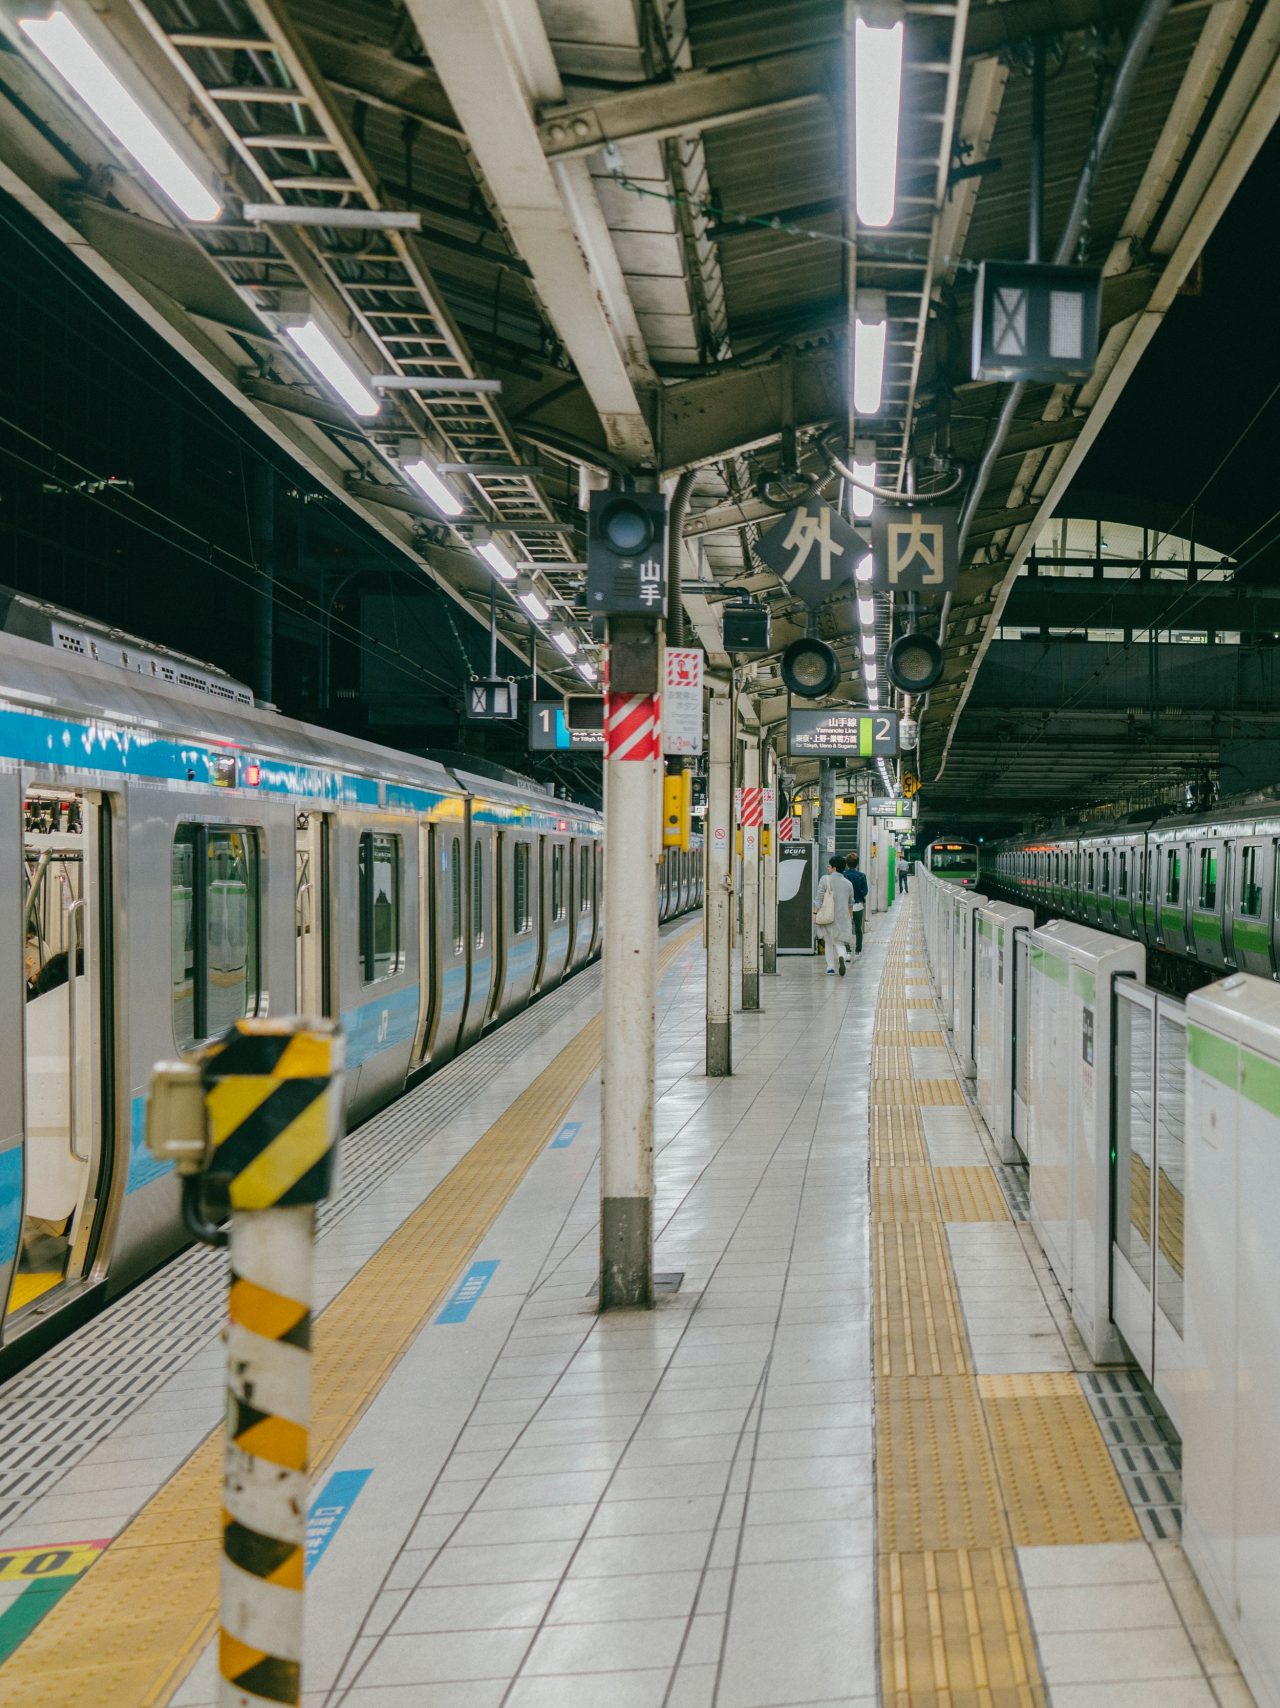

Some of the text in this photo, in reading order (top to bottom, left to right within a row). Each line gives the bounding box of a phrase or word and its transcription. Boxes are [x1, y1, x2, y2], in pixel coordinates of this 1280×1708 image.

[781, 506, 845, 583] 外
[887, 512, 944, 584] 内
[640, 560, 661, 606] 山手
[538, 709, 550, 733] 1
[828, 717, 857, 727] 山手線
[875, 718, 891, 741] 2
[903, 801, 910, 811] 2
